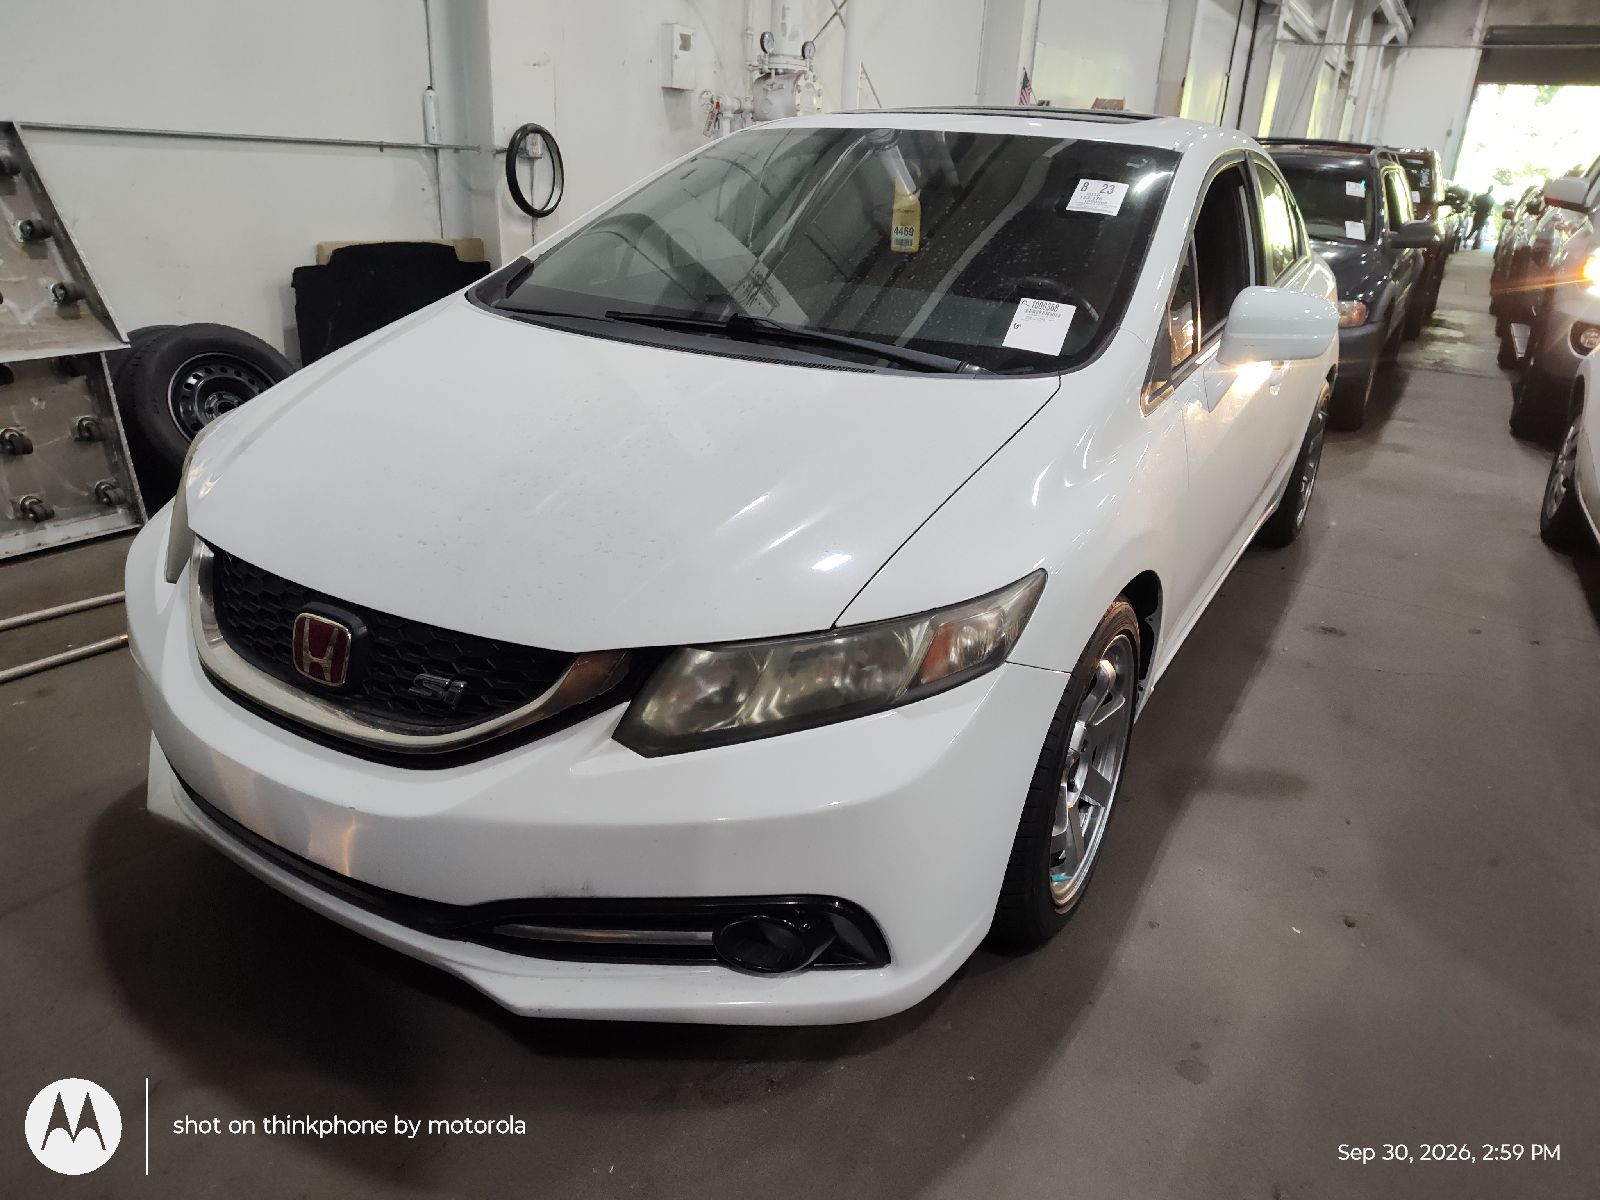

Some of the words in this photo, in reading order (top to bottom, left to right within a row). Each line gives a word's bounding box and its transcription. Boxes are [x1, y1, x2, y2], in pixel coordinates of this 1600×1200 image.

[1080, 181, 1090, 192] 8
[1100, 183, 1116, 195] 23
[894, 226, 914, 237] 4469
